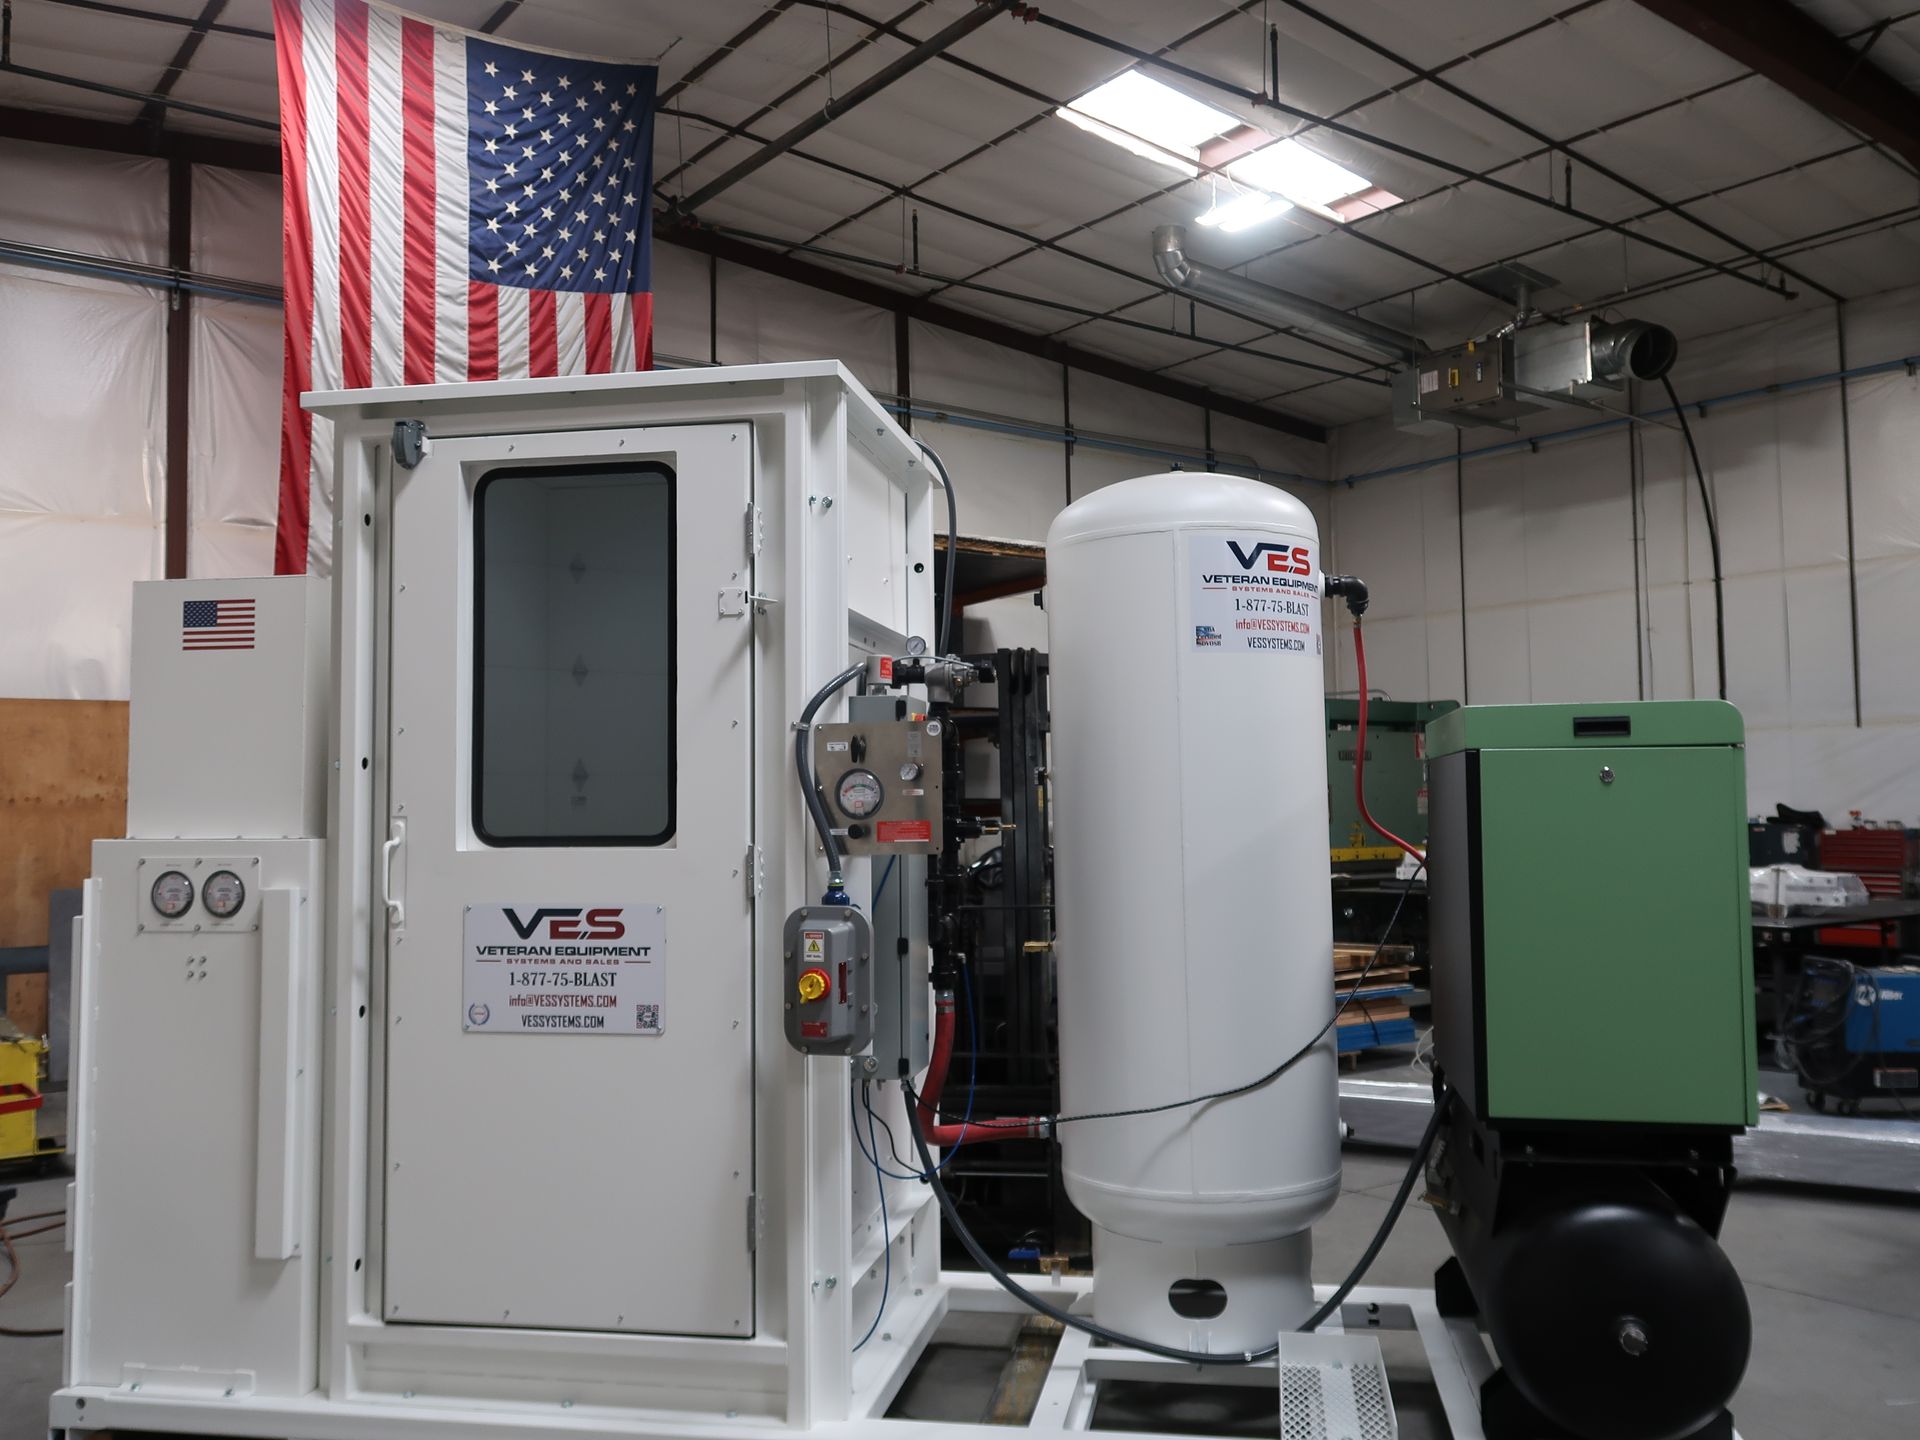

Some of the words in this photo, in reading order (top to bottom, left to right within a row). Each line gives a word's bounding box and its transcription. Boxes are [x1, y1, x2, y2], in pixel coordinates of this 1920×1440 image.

[1226, 541, 1310, 576] VES
[1202, 574, 1270, 585] VETERAN
[1272, 576, 1318, 593] EQUIPMENT
[1292, 590, 1310, 598] SALES
[1235, 598, 1309, 616] 1-877-75-BLAST
[1235, 619, 1310, 634] info@VESSYSTEMS.COM
[1247, 637, 1305, 652] VESSYSTEMS.COM
[502, 908, 625, 940] VES
[476, 945, 551, 956] VETERAN
[555, 946, 651, 957] EQUIPMENT
[509, 972, 617, 987] 1-877-75-BLAST
[509, 995, 617, 1008] info@VESSYSTEMS.COM
[521, 1015, 605, 1029] VESSYSTEMS.COM
